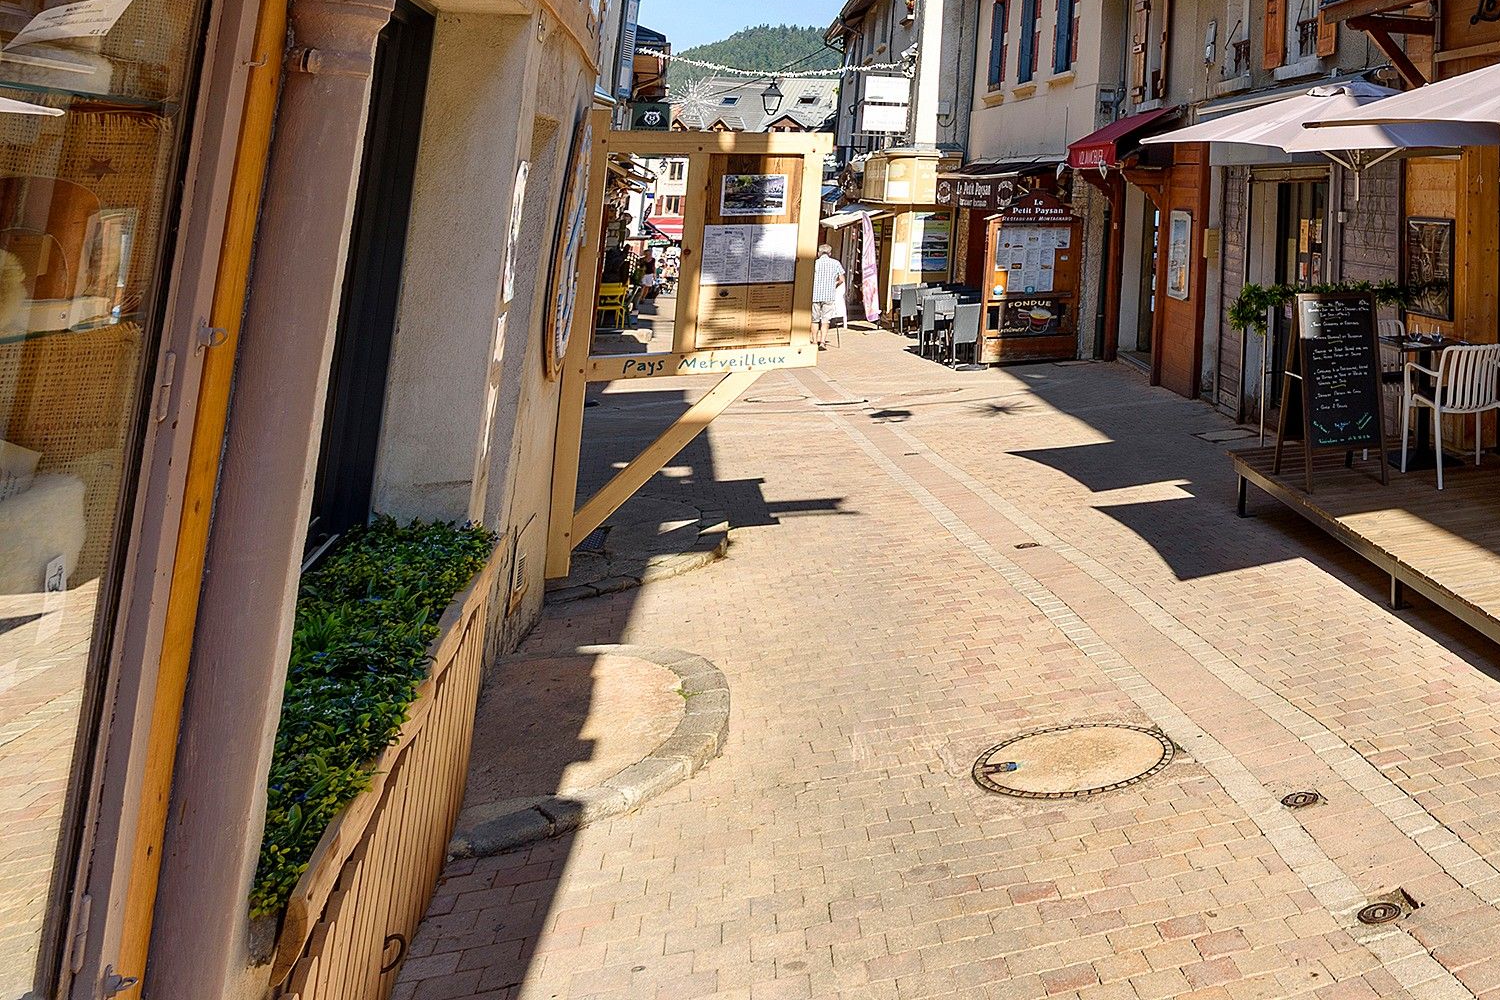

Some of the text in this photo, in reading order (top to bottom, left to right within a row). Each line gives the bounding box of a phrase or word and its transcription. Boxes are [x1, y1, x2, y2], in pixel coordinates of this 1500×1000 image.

[1035, 207, 1064, 215] Paysan
[1008, 300, 1052, 309] FONDUE
[623, 353, 786, 375] Pays Merveilleux
